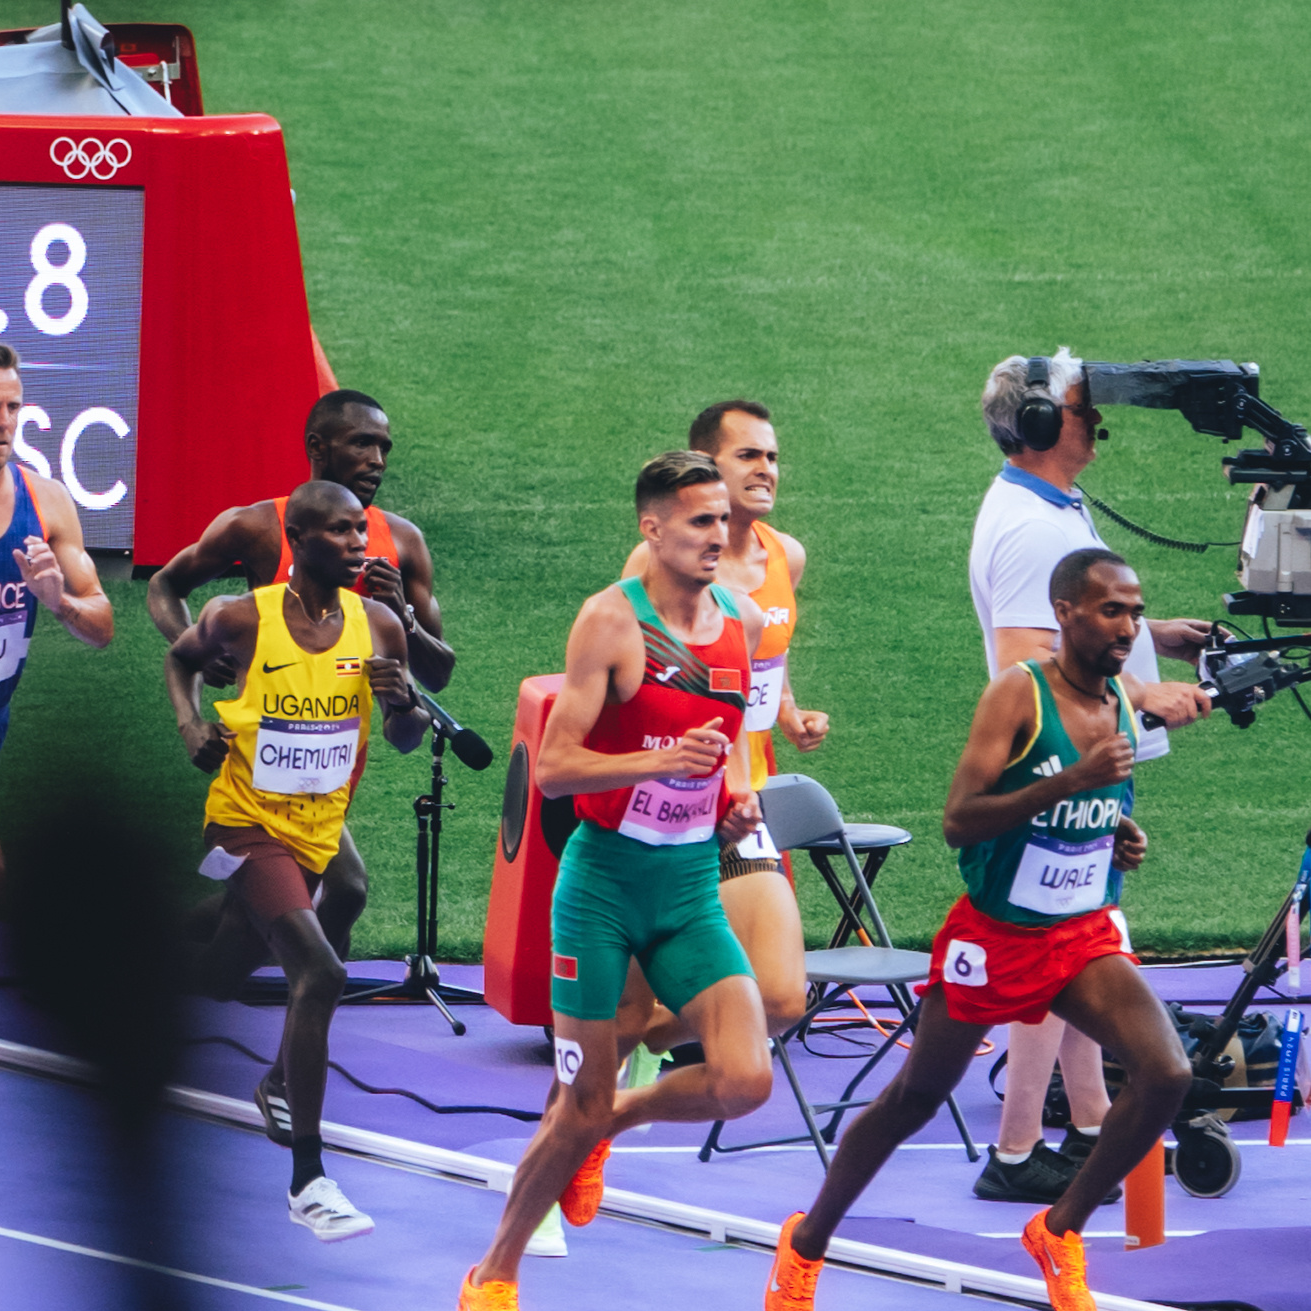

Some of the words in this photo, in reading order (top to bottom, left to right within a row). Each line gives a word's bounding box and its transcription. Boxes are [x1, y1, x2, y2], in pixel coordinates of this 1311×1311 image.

[263, 693, 359, 718] UGANDA
[260, 743, 352, 770] CHEMUTAI
[632, 790, 652, 816] EL
[1040, 864, 1097, 890] WALE
[954, 951, 972, 977] 6
[557, 1049, 579, 1075] 10
